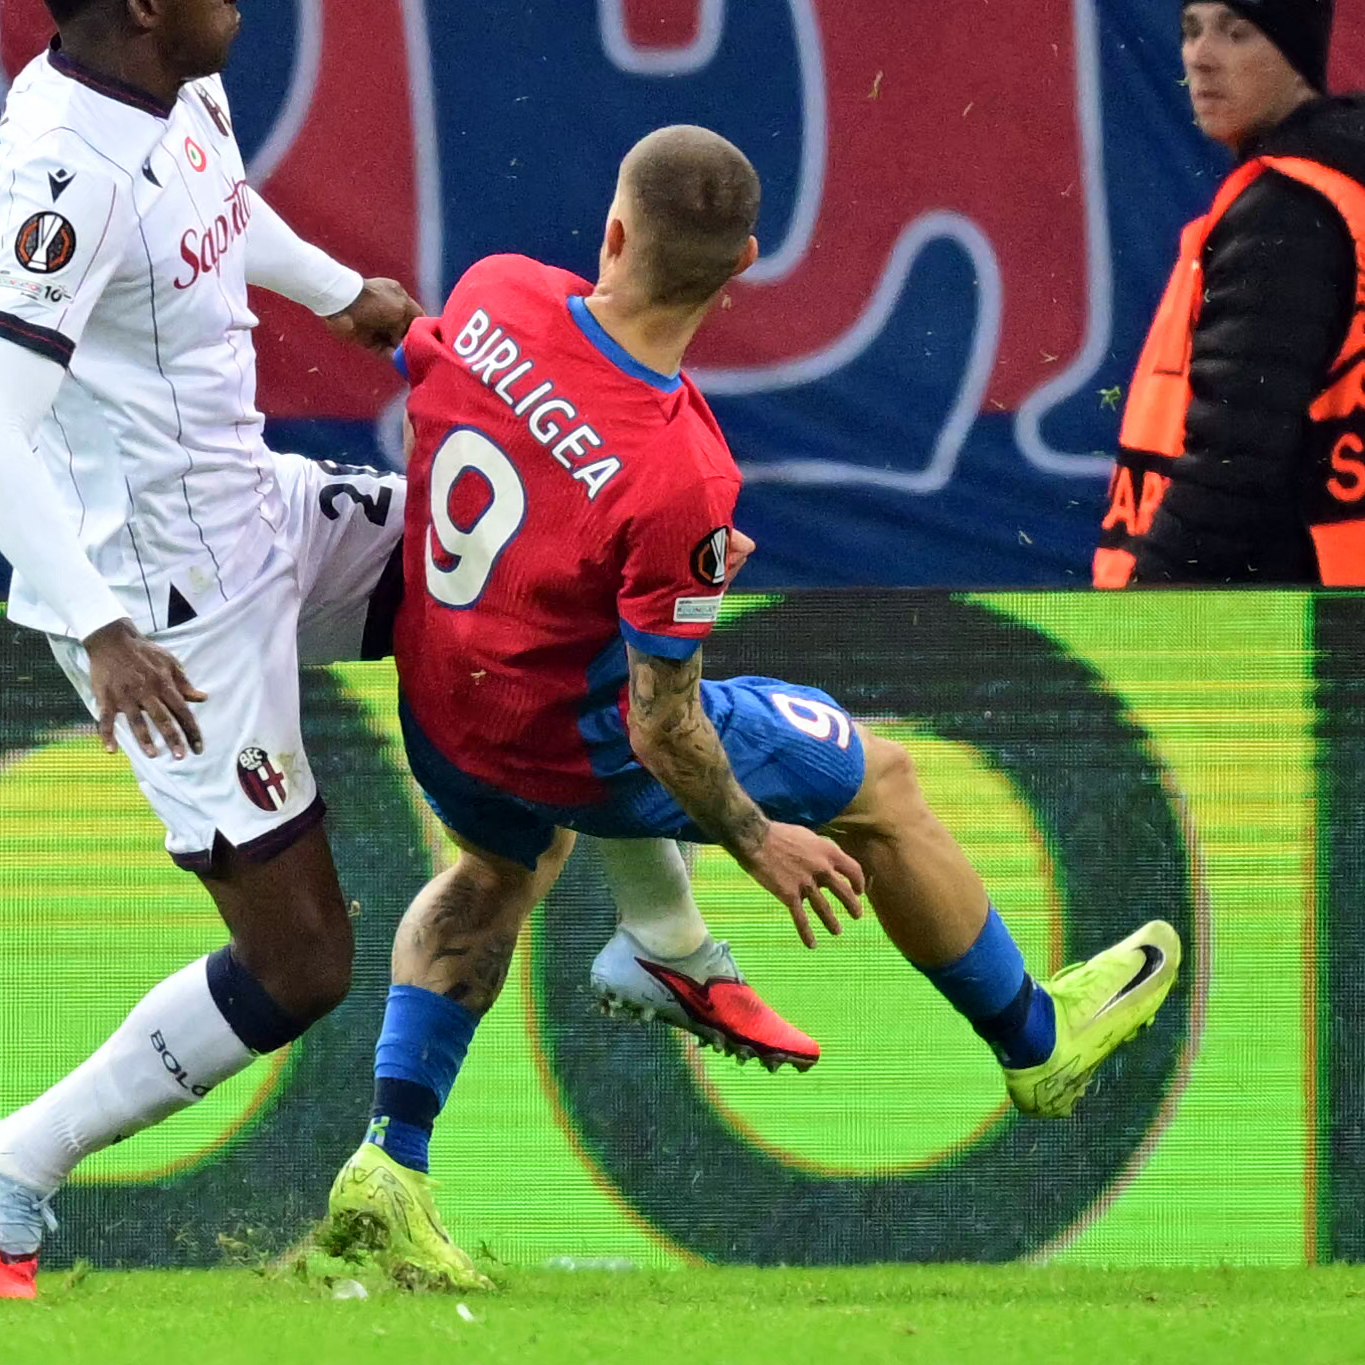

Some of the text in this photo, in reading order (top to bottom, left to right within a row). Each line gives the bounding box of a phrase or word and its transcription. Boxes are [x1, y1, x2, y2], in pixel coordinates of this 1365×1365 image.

[452, 307, 623, 502] BIRLIGEA
[424, 424, 528, 610] 9
[770, 691, 852, 752] 9
